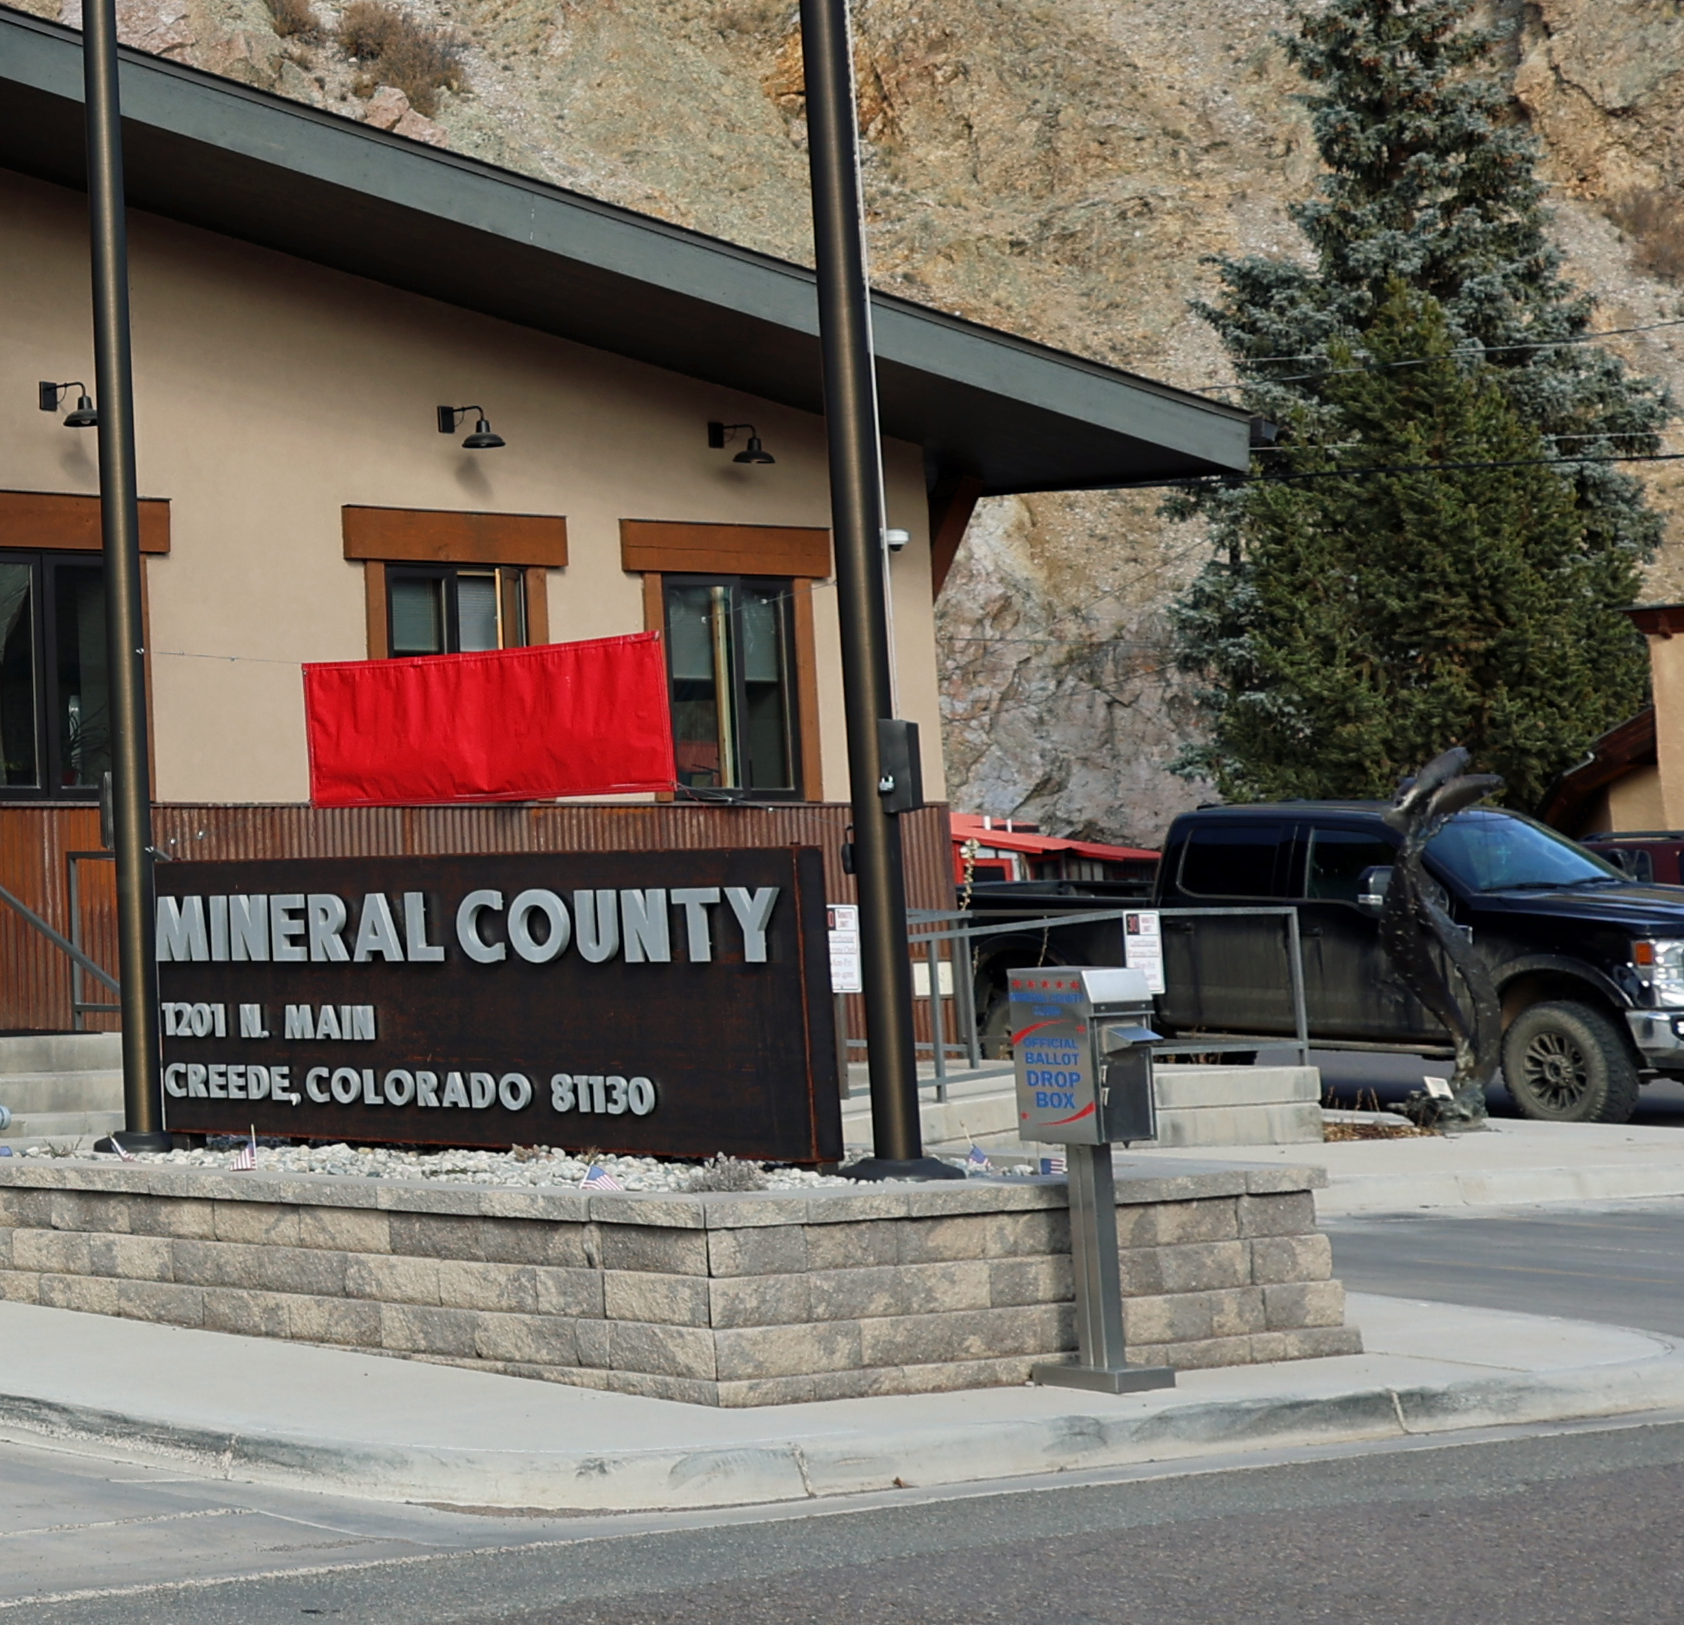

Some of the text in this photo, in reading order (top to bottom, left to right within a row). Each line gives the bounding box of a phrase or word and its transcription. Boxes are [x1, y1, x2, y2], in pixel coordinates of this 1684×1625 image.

[155, 887, 780, 963] MINERAL COUNTY
[161, 1002, 376, 1041] 1201 N. MAIN
[1023, 1037, 1079, 1049] OFFICIAL
[1025, 1052, 1079, 1066] BALLOT
[1026, 1070, 1081, 1088] DROP
[164, 1062, 656, 1115] CREEDE, COLORADO 81130
[1036, 1092, 1076, 1109] BOX
